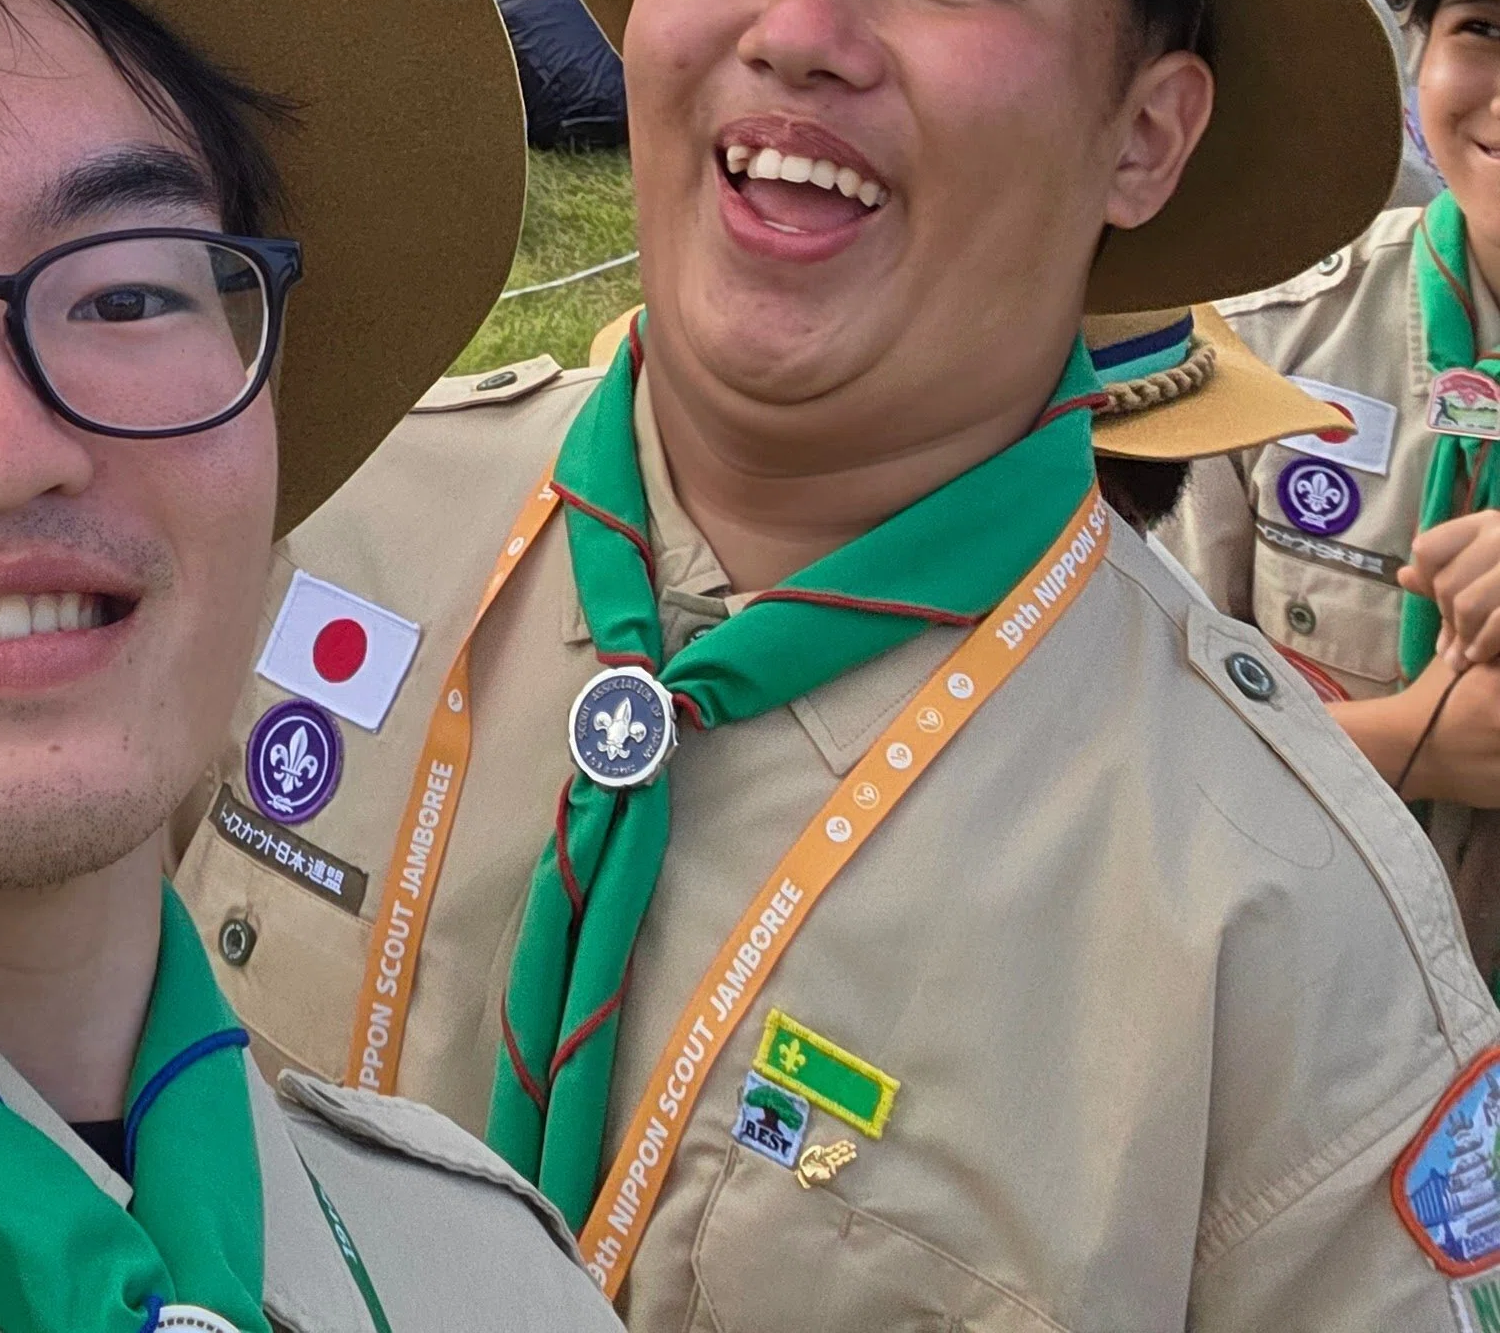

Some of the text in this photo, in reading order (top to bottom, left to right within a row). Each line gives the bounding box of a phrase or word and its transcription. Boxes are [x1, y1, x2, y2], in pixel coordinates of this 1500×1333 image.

[995, 602, 1042, 651] 19th
[1032, 524, 1097, 610] NIPPON
[577, 703, 592, 741] SCOUT
[591, 678, 653, 703] ASSOCIATION
[376, 898, 415, 998] SCOUT
[399, 758, 455, 901] JAMBOREE
[606, 1115, 670, 1237] NIPPON
[658, 1014, 716, 1121] SCOUT
[709, 876, 805, 1023] JAMBOREE
